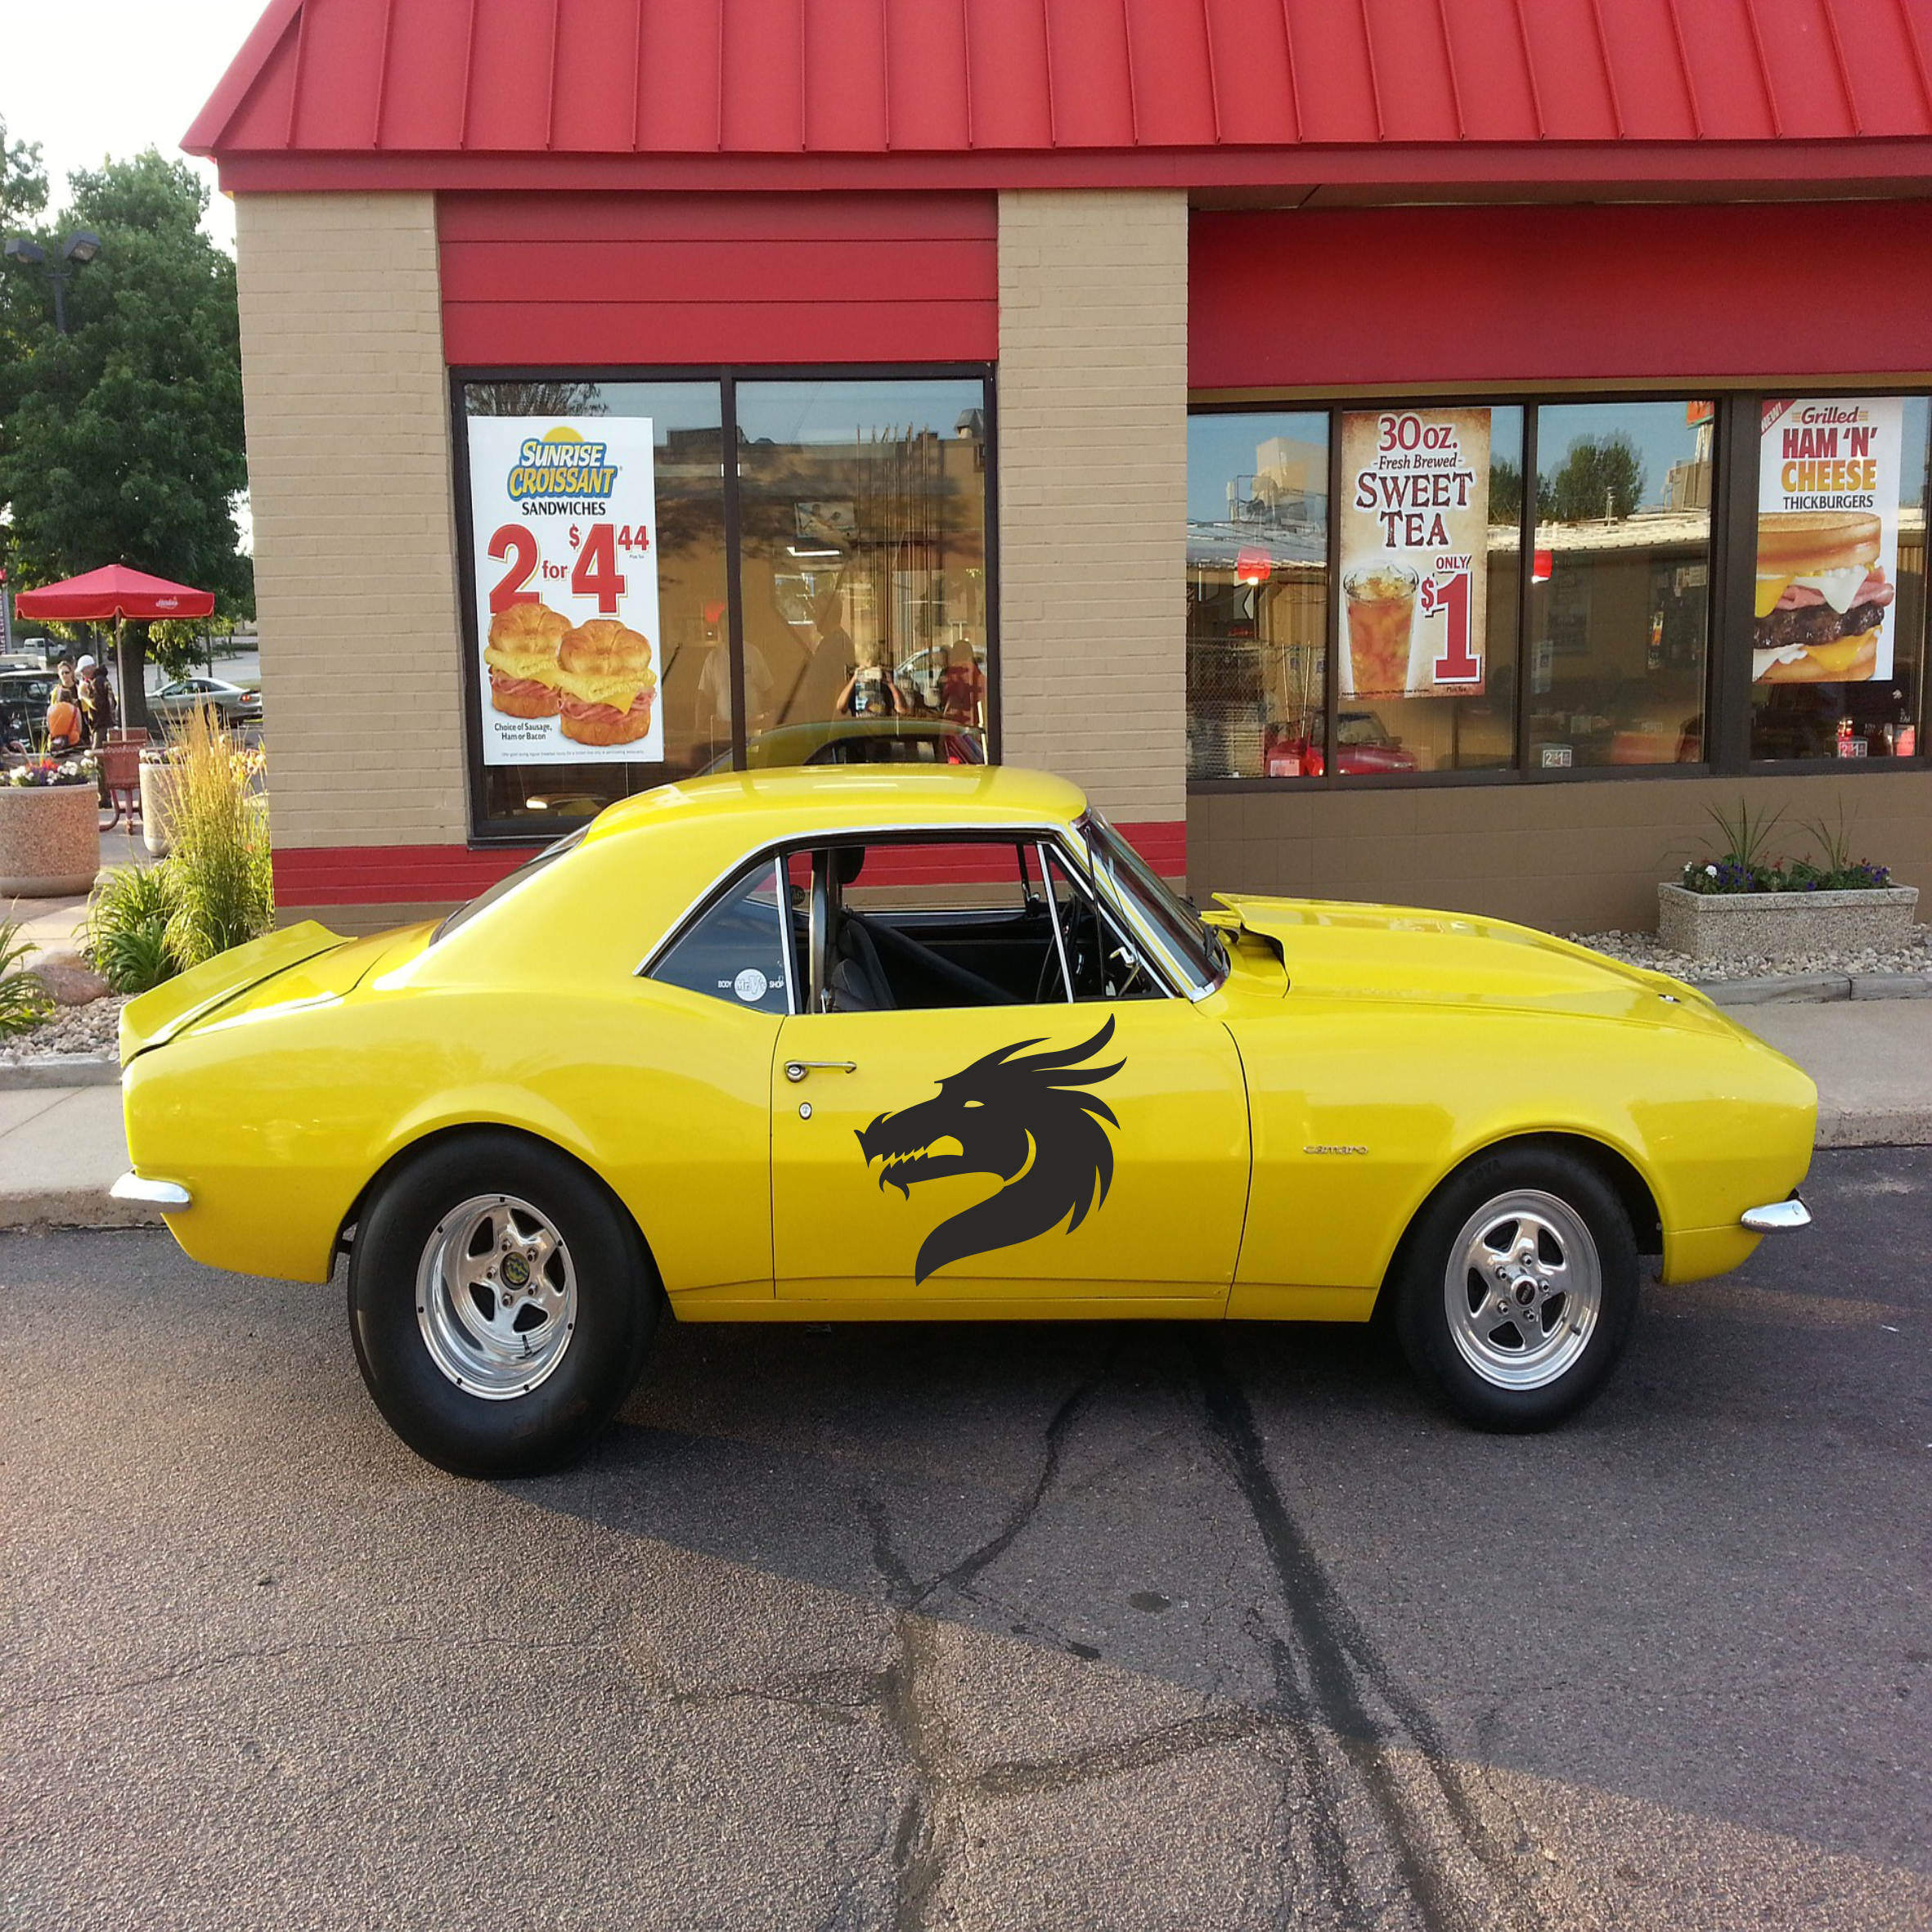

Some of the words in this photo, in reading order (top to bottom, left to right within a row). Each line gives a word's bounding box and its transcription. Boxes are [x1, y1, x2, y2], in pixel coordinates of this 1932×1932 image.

[1761, 402, 1783, 432] NEW!
[1801, 407, 1859, 424] Grilled
[520, 441, 604, 468] SUNRISE
[1782, 428, 1838, 459] HAM
[509, 466, 617, 497] CROISSANT
[1781, 459, 1877, 492] CHEESE
[1356, 472, 1473, 509] SWEET
[1783, 495, 1873, 510] THICKBURGERS
[522, 501, 605, 515] SANDWICHES
[1380, 510, 1449, 547] TEA
[487, 523, 541, 613] 2
[541, 560, 568, 579] for
[1436, 556, 1468, 570] ONLY
[494, 722, 517, 731] Choice
[517, 722, 523, 730] of
[524, 722, 552, 733] Sausage,
[501, 732, 517, 740] Ham
[526, 732, 546, 740] Bacon
[717, 980, 733, 989] BODY
